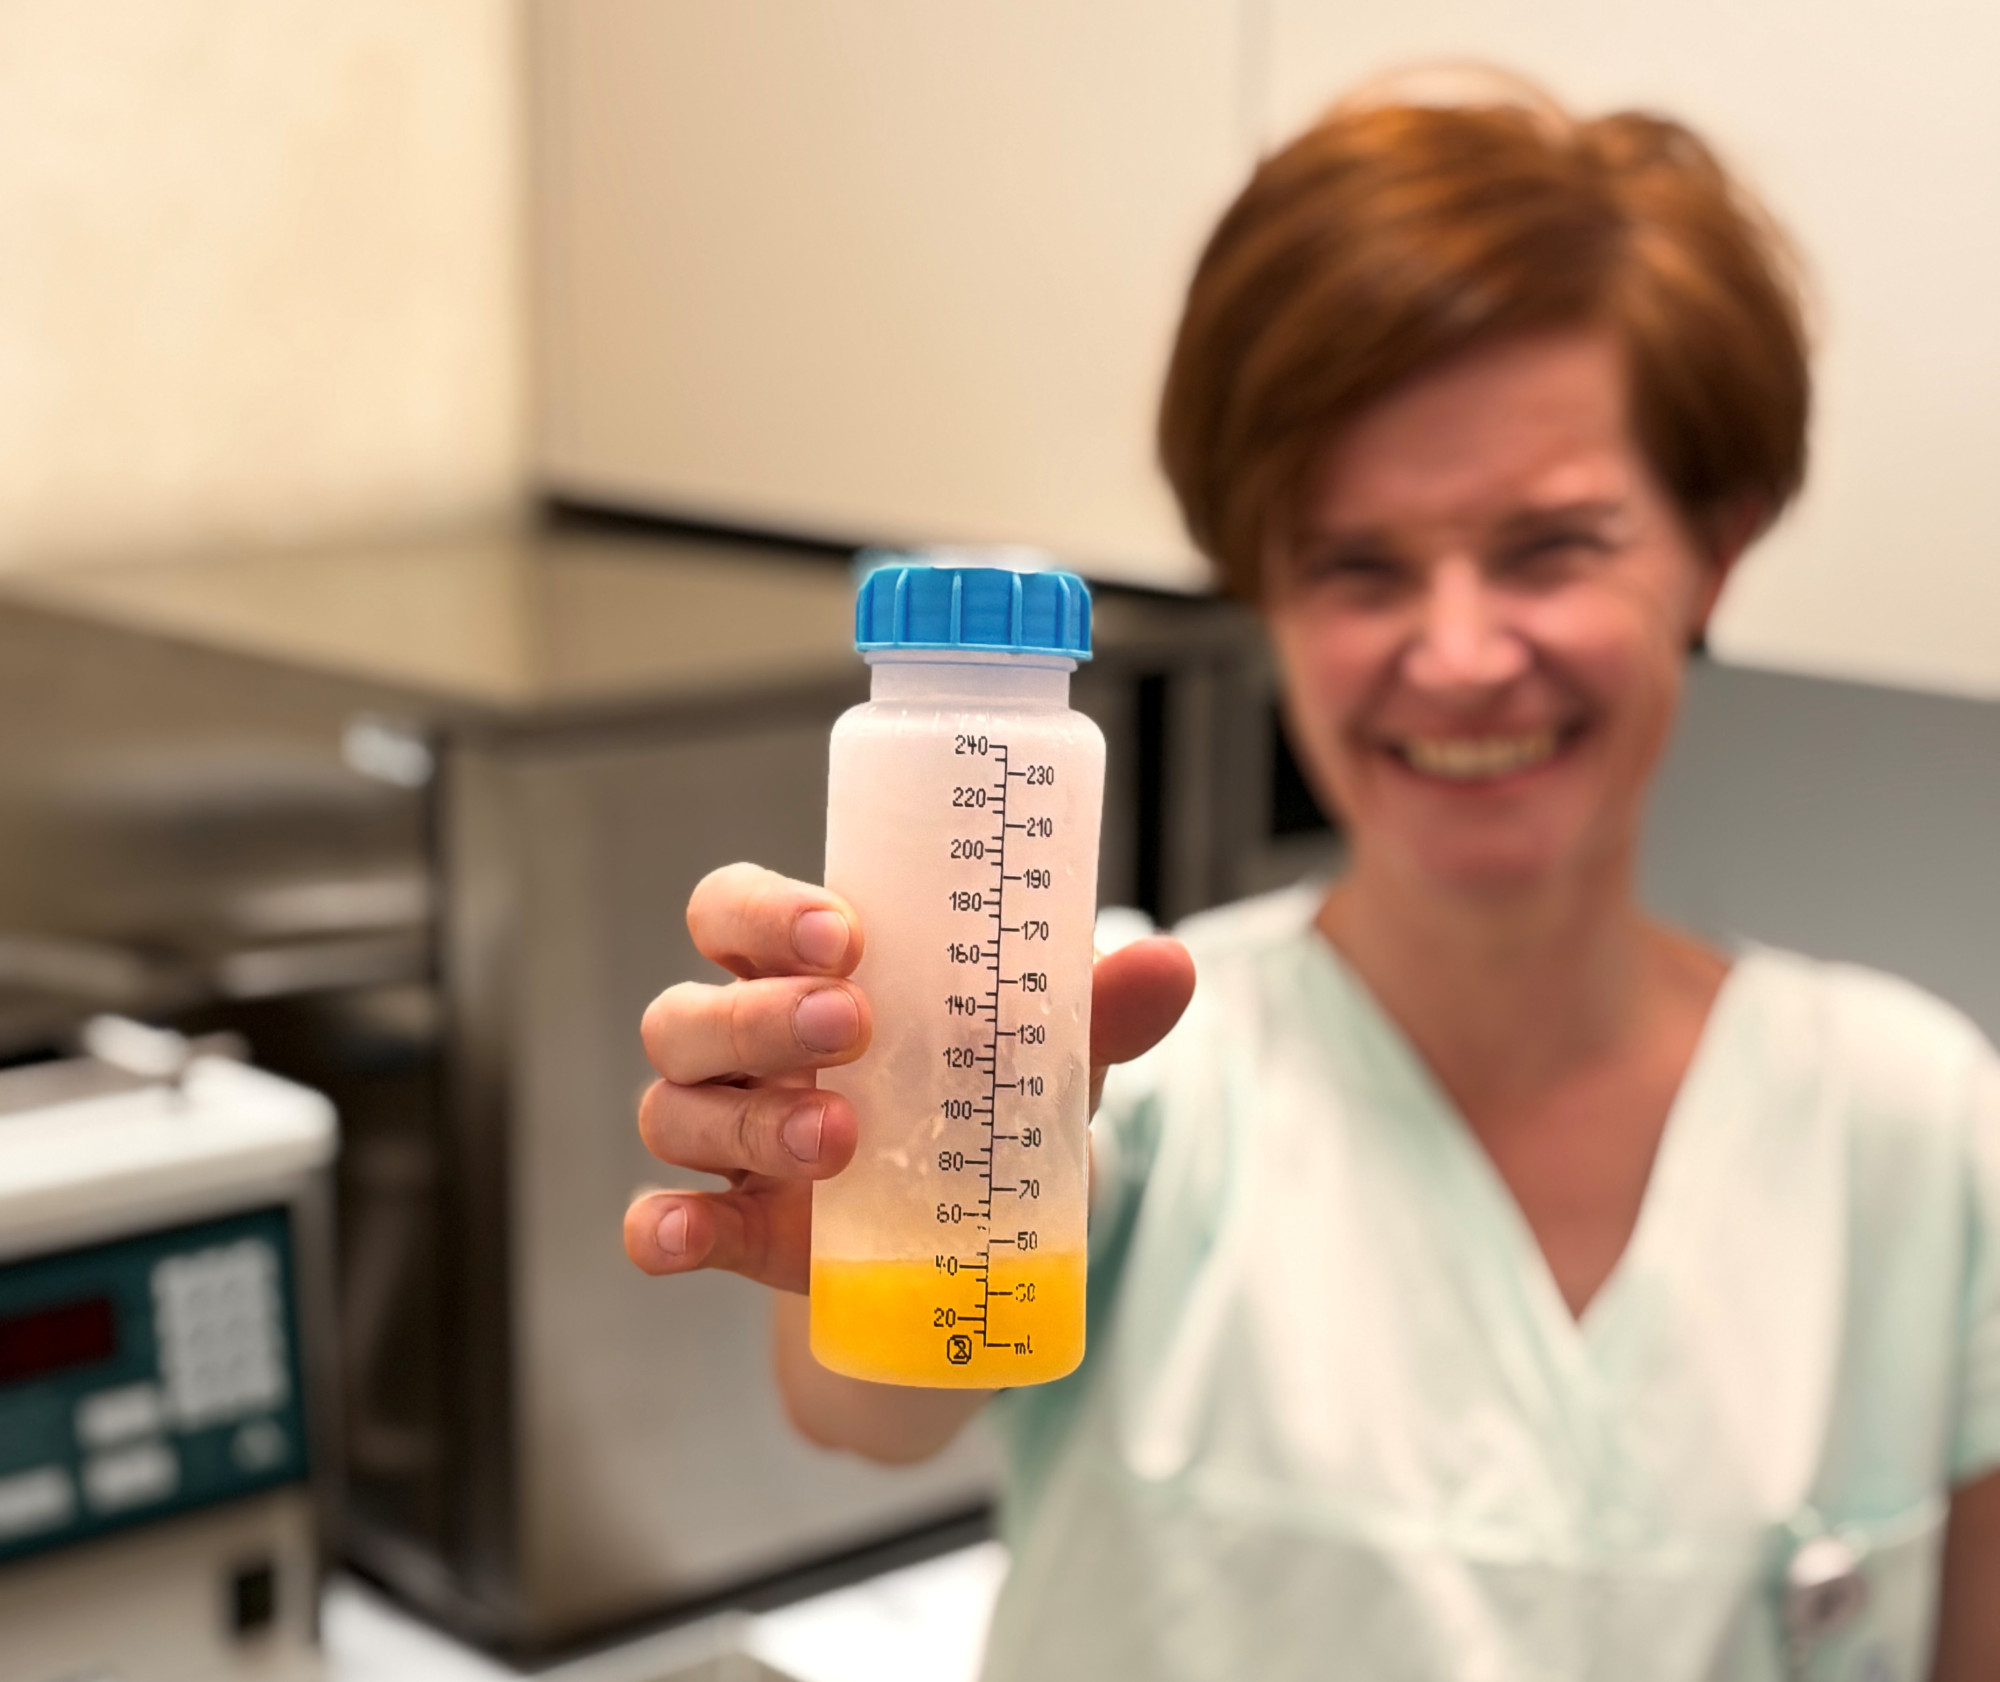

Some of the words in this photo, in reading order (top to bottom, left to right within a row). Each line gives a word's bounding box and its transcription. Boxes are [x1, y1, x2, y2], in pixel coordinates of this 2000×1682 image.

[955, 734, 988, 756] 240
[1026, 765, 1054, 785] 230
[952, 787, 986, 808] 220
[1026, 817, 1053, 838] 210
[950, 839, 984, 860] 200
[1023, 868, 1051, 889] 190
[949, 891, 982, 912] 180
[1021, 920, 1049, 941] 170
[947, 943, 980, 964] 160
[1019, 972, 1047, 992] 150
[945, 995, 976, 1016] 140
[1017, 1024, 1045, 1045] 130
[943, 1047, 974, 1068] 120
[1017, 1076, 1044, 1096] 110
[941, 1099, 972, 1120] 100
[938, 1151, 964, 1172] 80
[1019, 1179, 1040, 1199] 70
[936, 1203, 962, 1224] 60
[1017, 1231, 1038, 1251] 50
[933, 1307, 956, 1328] 20
[1014, 1334, 1033, 1355] ml
